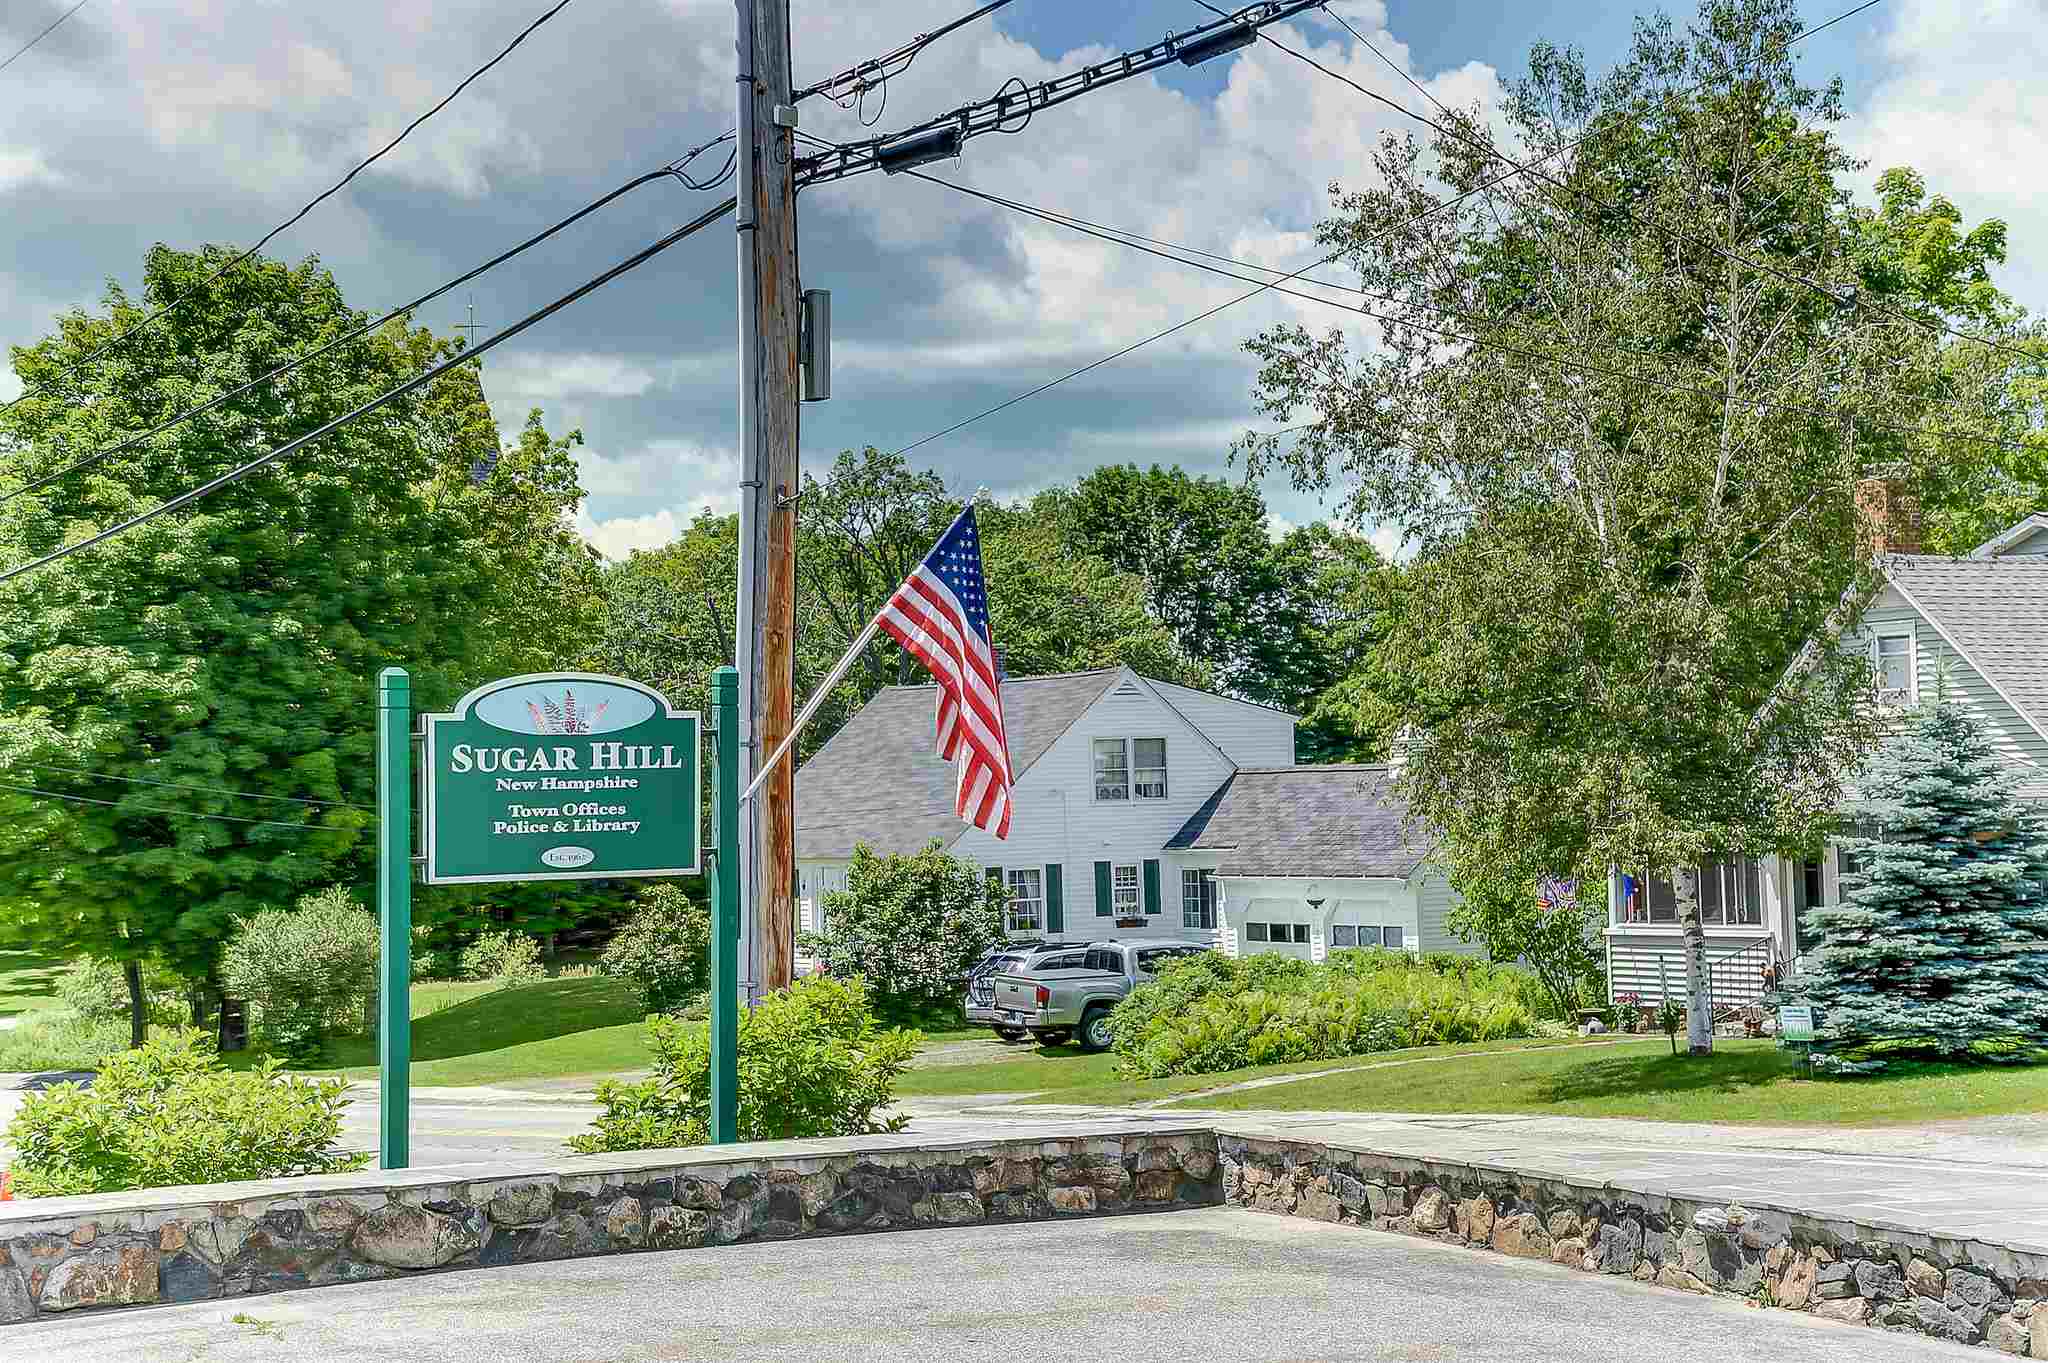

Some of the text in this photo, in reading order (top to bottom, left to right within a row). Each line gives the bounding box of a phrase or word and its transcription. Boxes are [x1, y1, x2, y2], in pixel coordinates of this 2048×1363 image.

[451, 742, 682, 772] SUGAR HILL
[496, 776, 639, 792] New Hampshire
[508, 802, 627, 817] Town Offices
[493, 819, 640, 834] Police & Library
